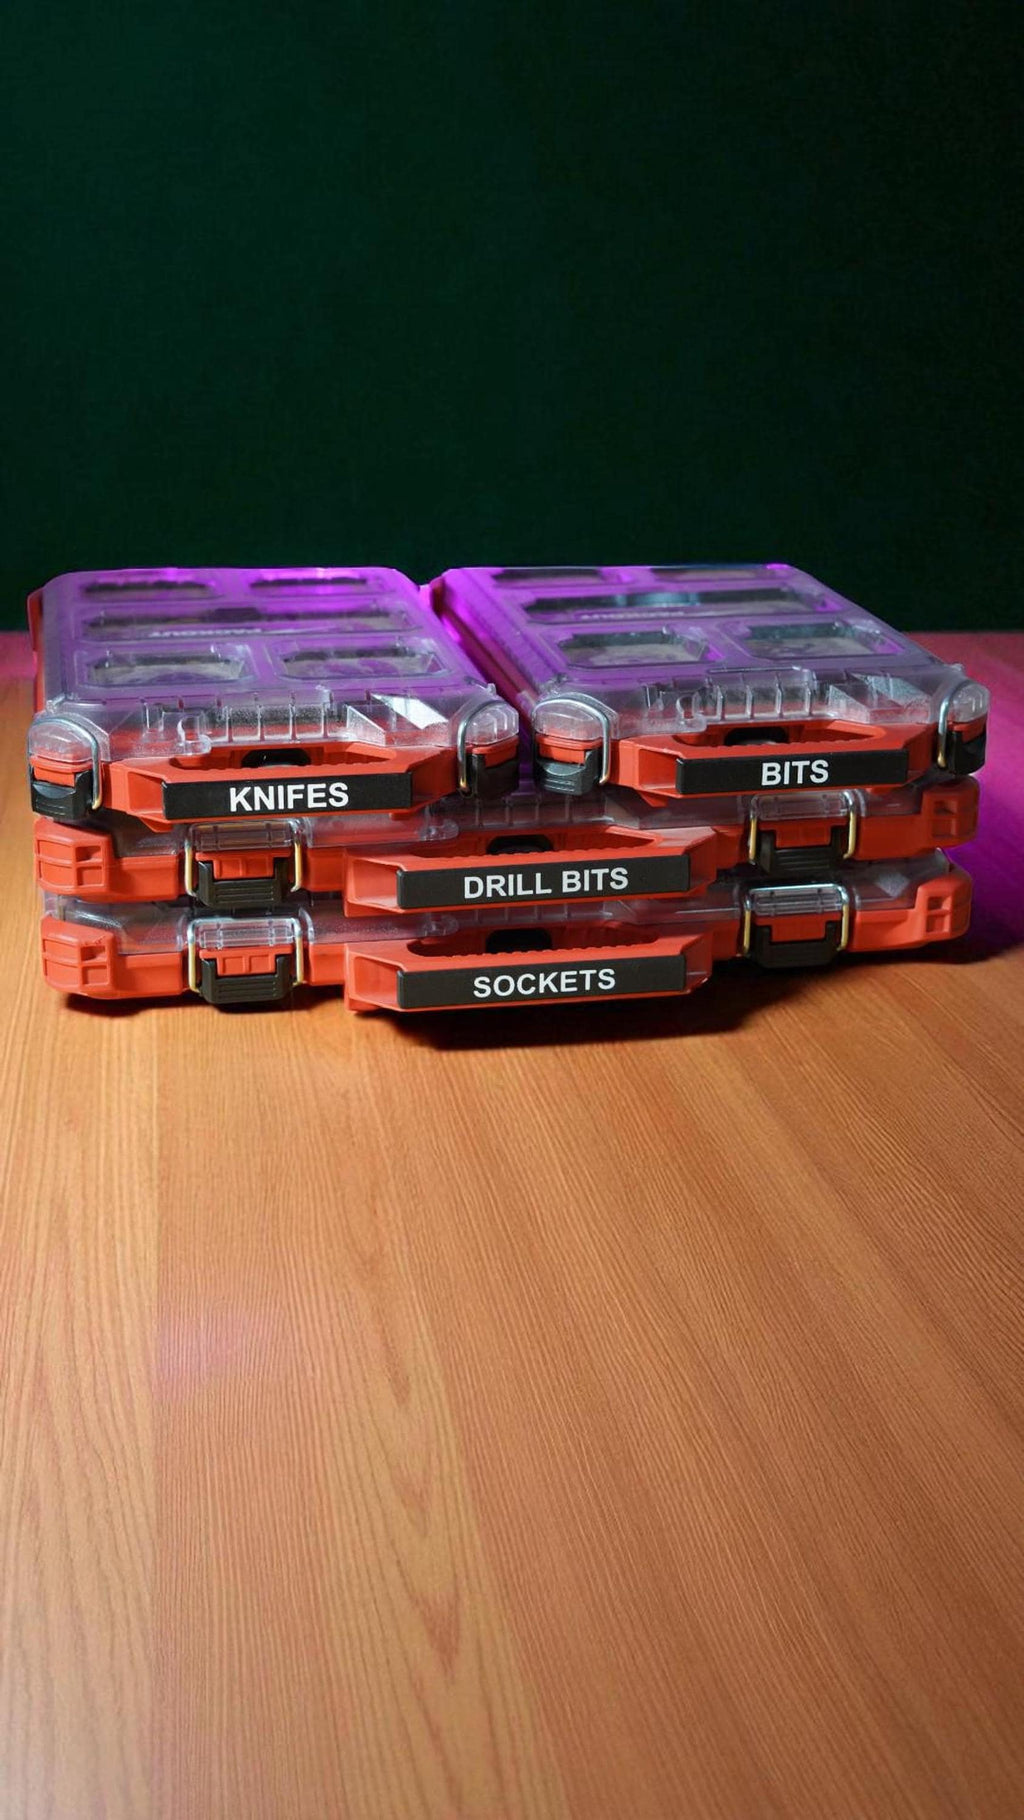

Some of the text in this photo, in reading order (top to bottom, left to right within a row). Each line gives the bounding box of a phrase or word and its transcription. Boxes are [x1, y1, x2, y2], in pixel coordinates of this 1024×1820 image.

[761, 759, 829, 786] BITS
[229, 782, 349, 813] KNIFES
[464, 867, 629, 899] DRILL BITS
[473, 968, 616, 998] SOCKETS
